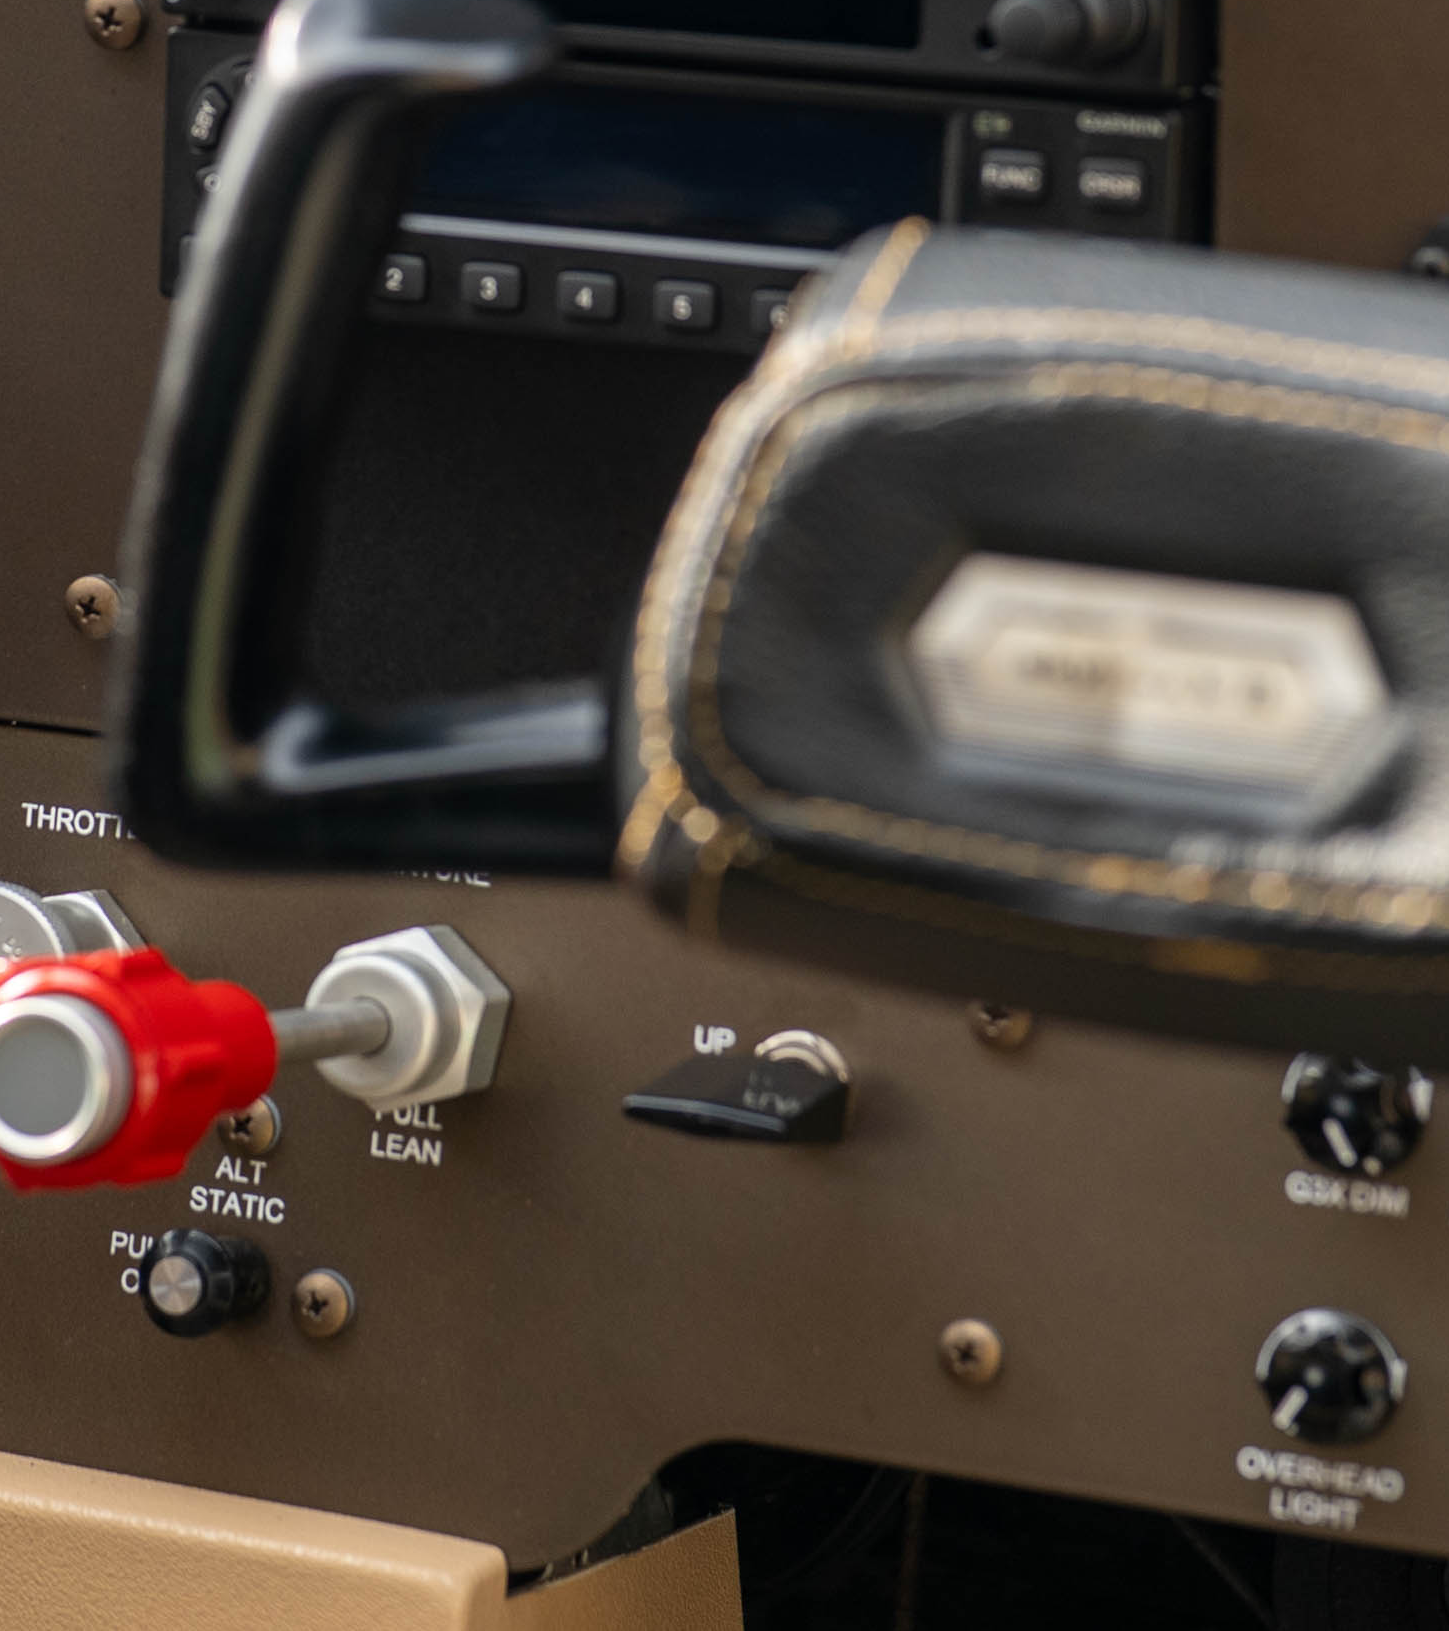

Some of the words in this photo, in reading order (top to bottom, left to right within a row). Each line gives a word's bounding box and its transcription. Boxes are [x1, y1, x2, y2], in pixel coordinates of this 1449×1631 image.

[21, 802, 136, 841] THROTT
[694, 1024, 736, 1056] UP
[370, 1131, 442, 1166] LEAN
[214, 1155, 267, 1186] ALT
[189, 1187, 285, 1225] STATIC
[1348, 1181, 1409, 1219] DIM
[1236, 1446, 1404, 1503] OVERHEAD
[1268, 1490, 1364, 1533] LIGHT
